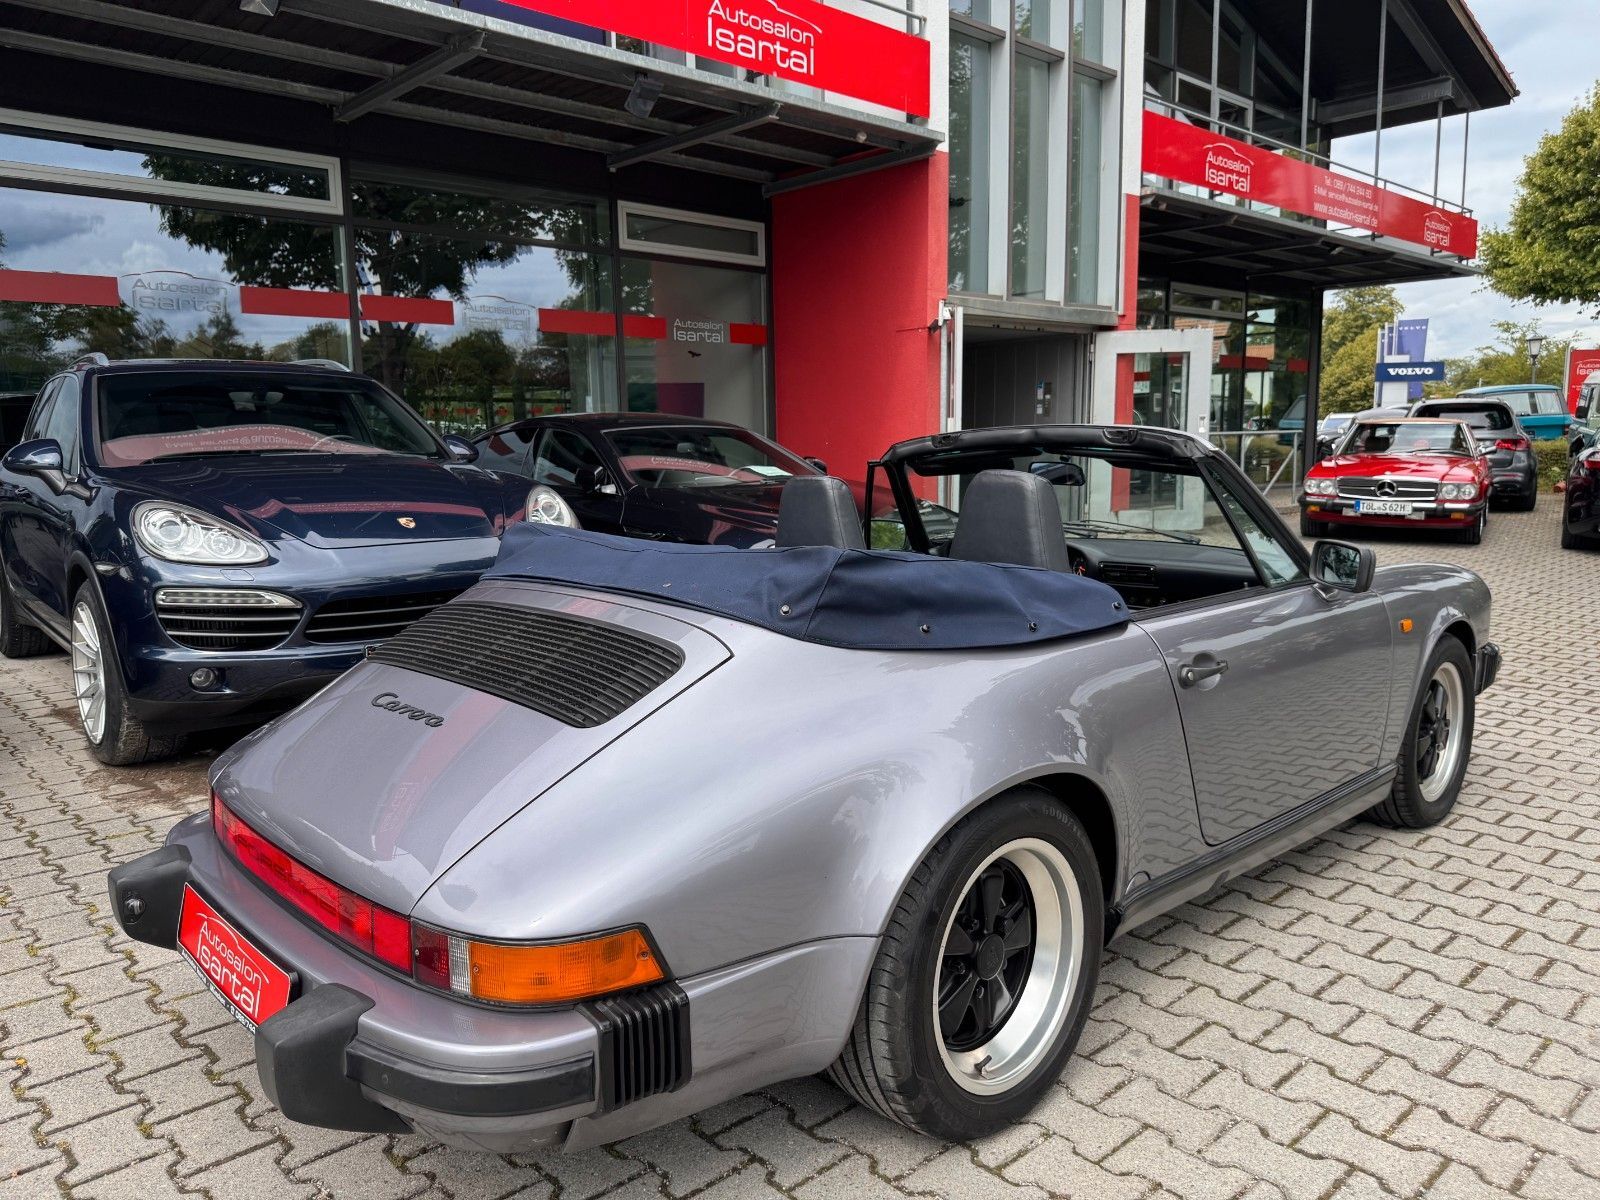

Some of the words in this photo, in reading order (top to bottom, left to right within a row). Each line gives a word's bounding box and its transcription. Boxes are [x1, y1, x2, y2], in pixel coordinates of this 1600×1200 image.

[708, 0, 815, 46] Autosalon
[707, 16, 815, 76] Isartal
[1206, 151, 1251, 175] Autosalon
[1205, 162, 1251, 193] Isartal
[1424, 226, 1450, 247] Isartal
[132, 278, 228, 296] Autosalon
[132, 290, 228, 316] Isartal
[464, 303, 531, 317] Autosalon
[673, 318, 724, 330] Autosalon
[673, 327, 724, 343] Isartal
[1387, 367, 1434, 376] VOLVO
[371, 691, 445, 728] Carrera
[200, 920, 263, 991] Autosalon
[196, 933, 262, 1019] Isartal
